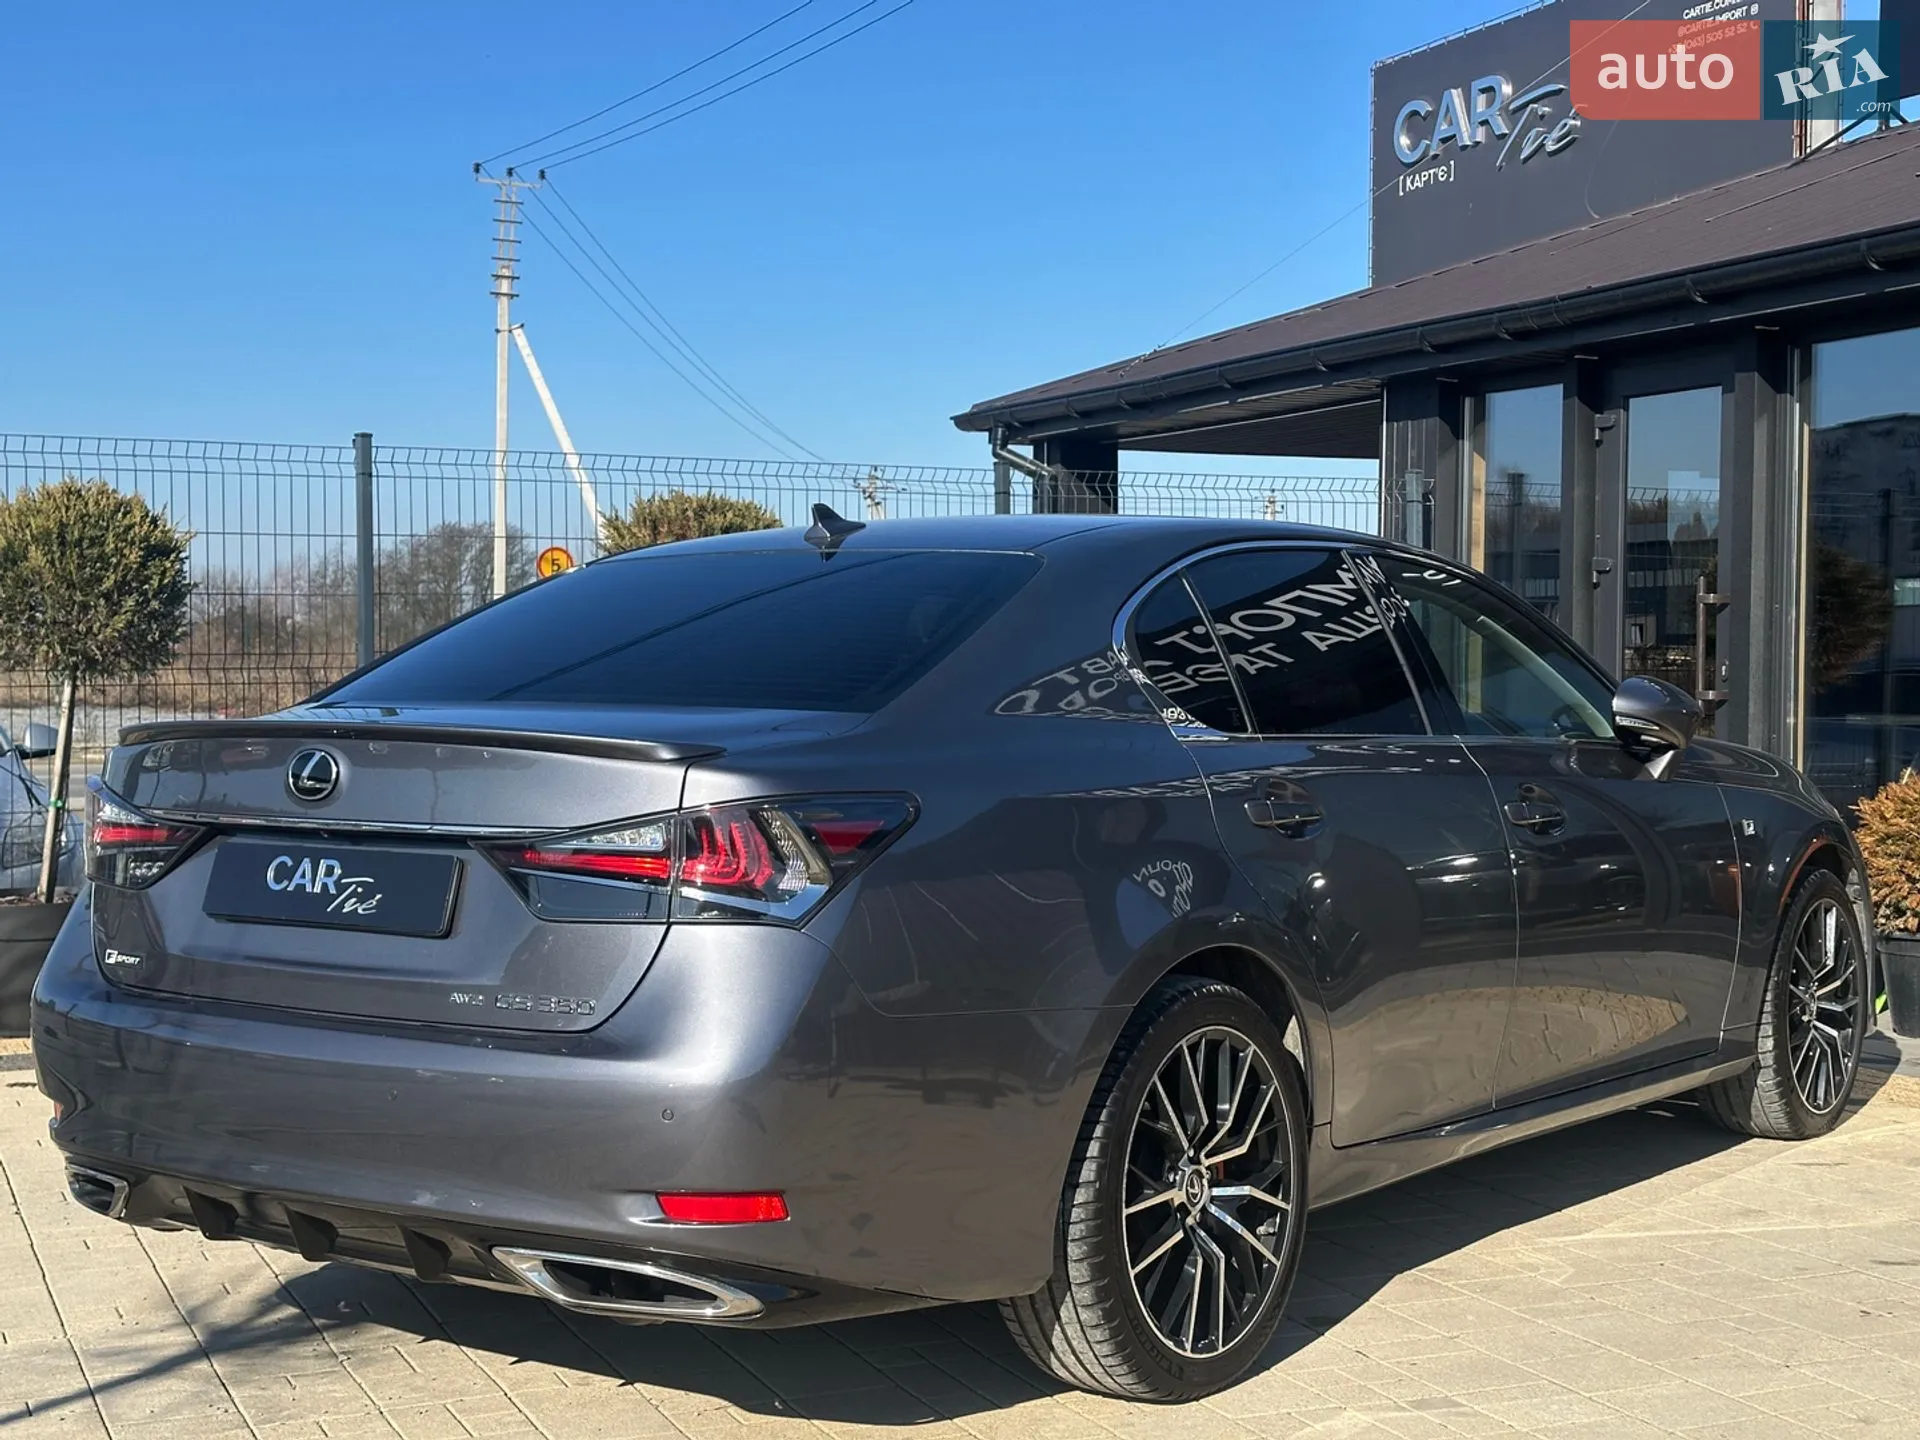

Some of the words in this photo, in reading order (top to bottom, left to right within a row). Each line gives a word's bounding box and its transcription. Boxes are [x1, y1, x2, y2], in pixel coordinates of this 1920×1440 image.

[1393, 74, 1512, 167] CAR
[551, 558, 561, 572] 5
[266, 855, 342, 894] CAR
[116, 954, 141, 965] SPORT
[495, 993, 534, 1011] GS
[538, 994, 596, 1015] 350
